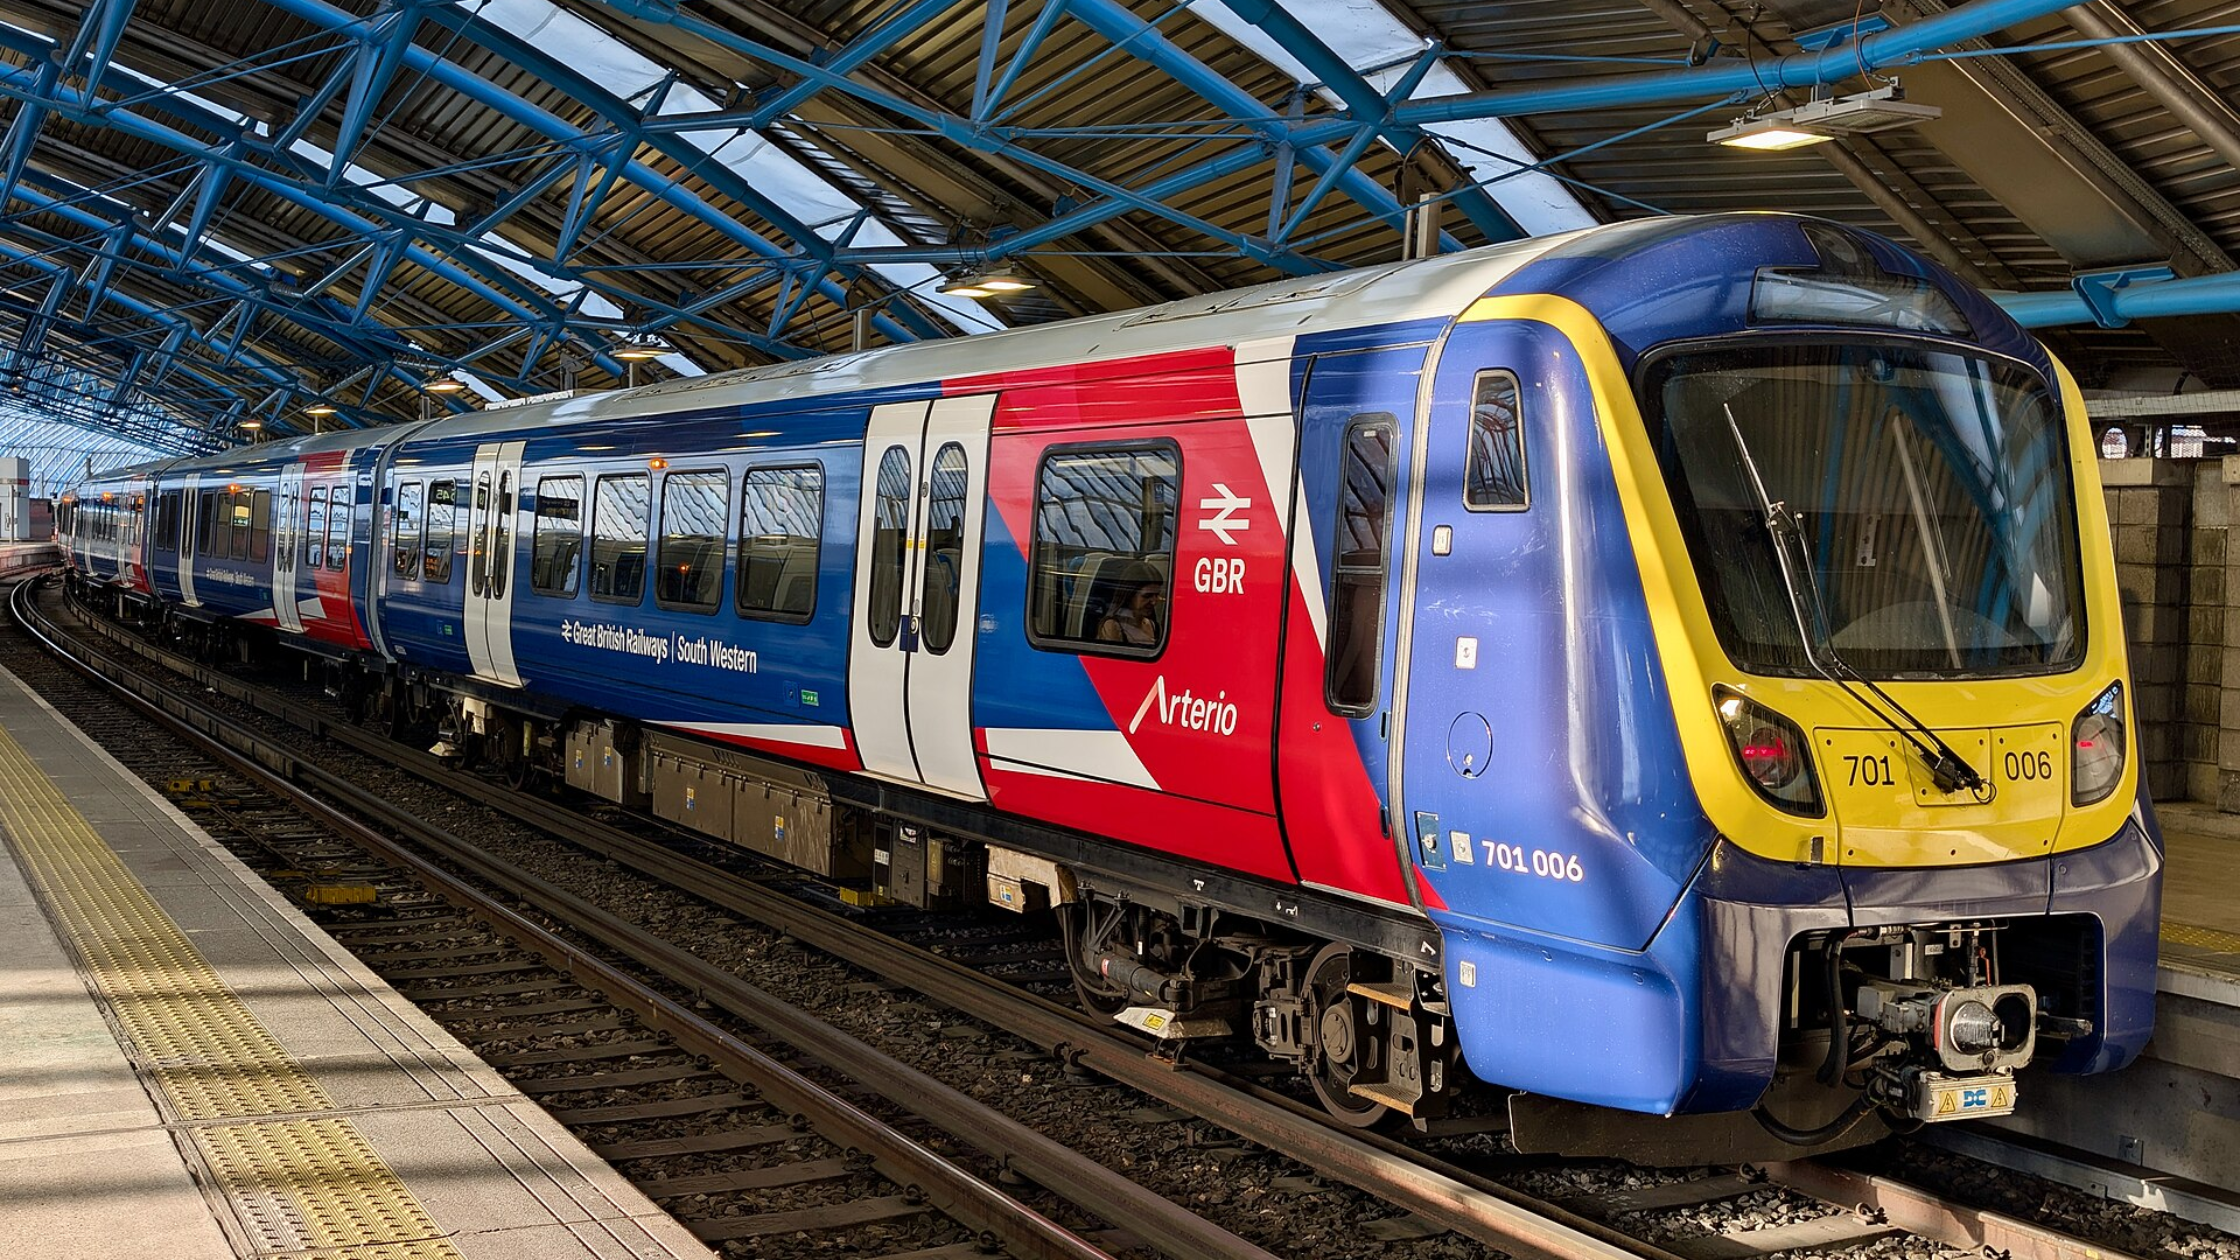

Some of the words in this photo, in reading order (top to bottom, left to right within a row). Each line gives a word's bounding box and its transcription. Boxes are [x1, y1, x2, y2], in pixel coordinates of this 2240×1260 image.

[1194, 557, 1246, 595] GBR
[573, 620, 597, 647] Great
[597, 622, 625, 652] British
[626, 627, 668, 664] Railways
[677, 635, 708, 666] South
[710, 640, 757, 674] Western
[1128, 675, 1238, 736] Arterio
[1843, 755, 1895, 787] 701
[2004, 751, 2052, 782] 006
[1481, 840, 1530, 874] 701
[1532, 849, 1584, 882] 006
